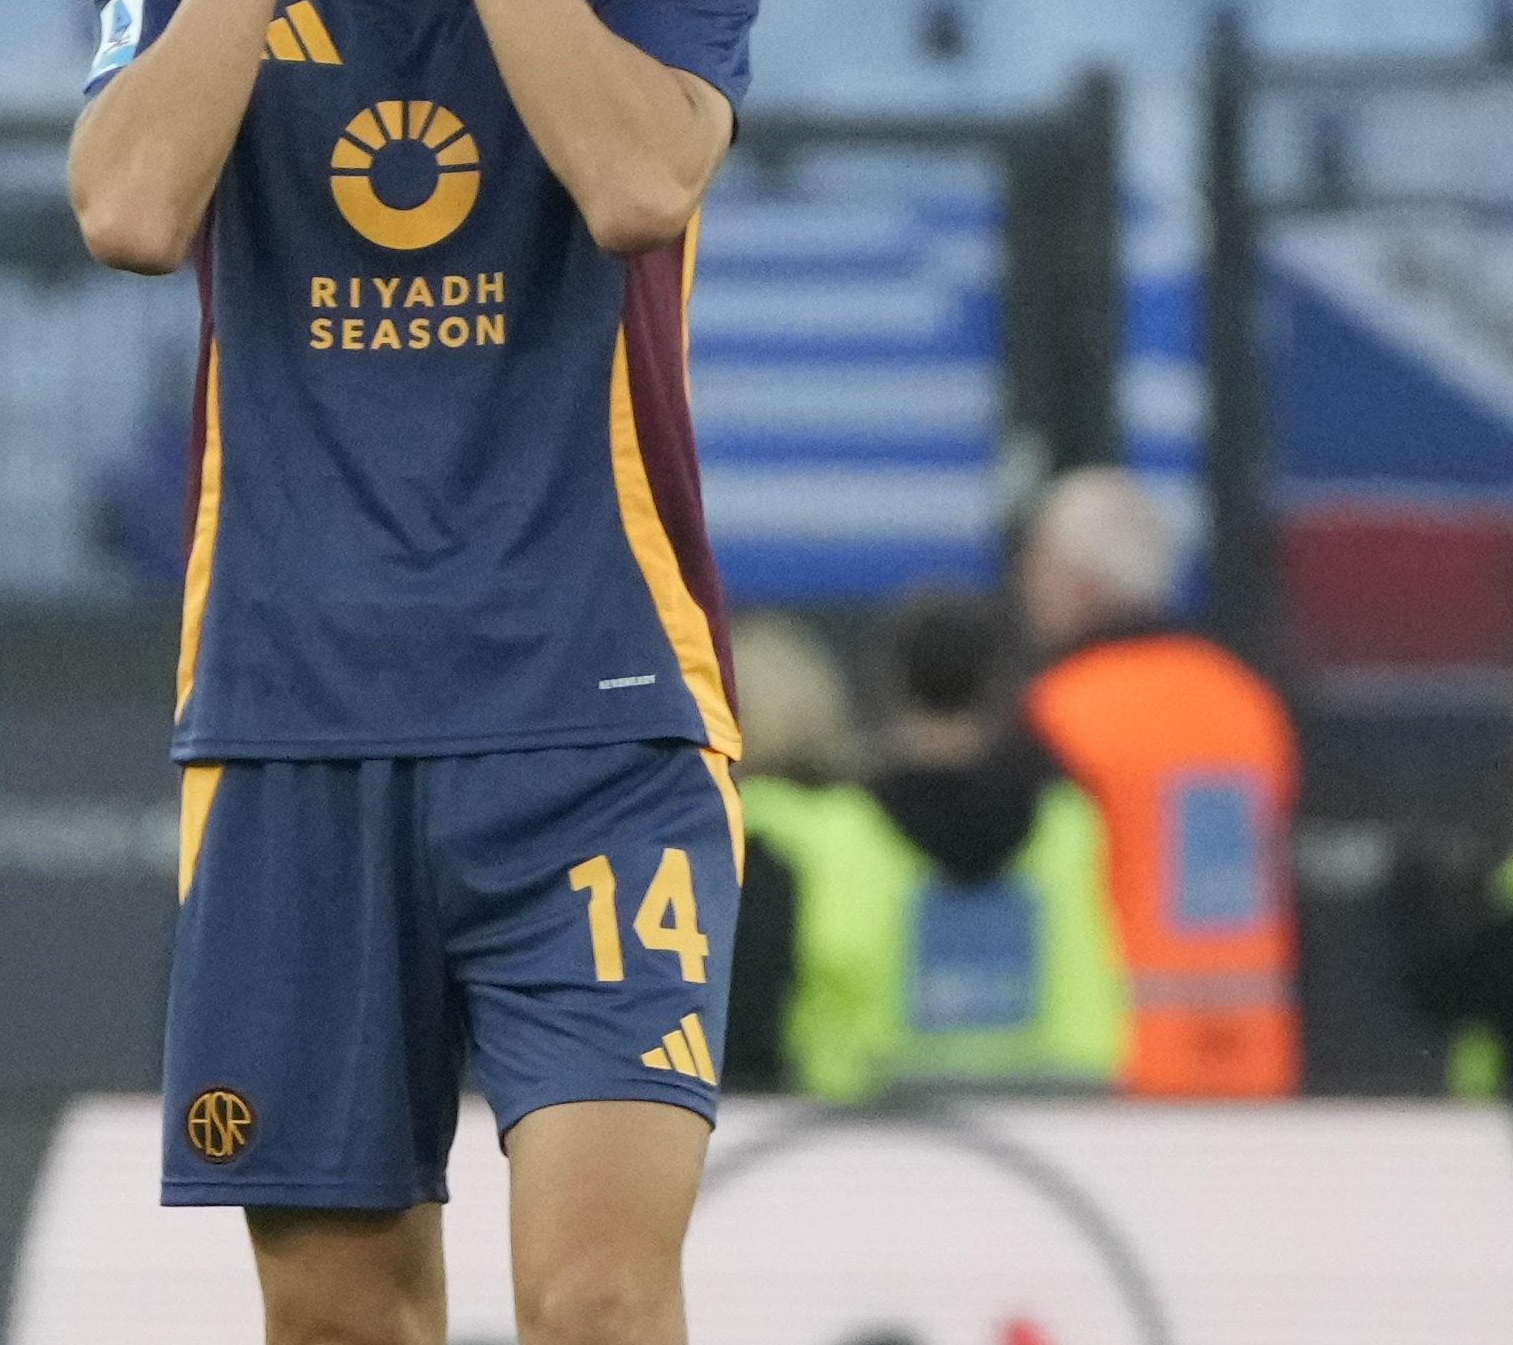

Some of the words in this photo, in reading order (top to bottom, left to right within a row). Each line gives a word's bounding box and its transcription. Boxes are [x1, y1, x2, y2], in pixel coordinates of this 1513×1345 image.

[309, 271, 506, 309] RIYADH
[308, 313, 507, 351] SEASON
[568, 847, 710, 984] 14
